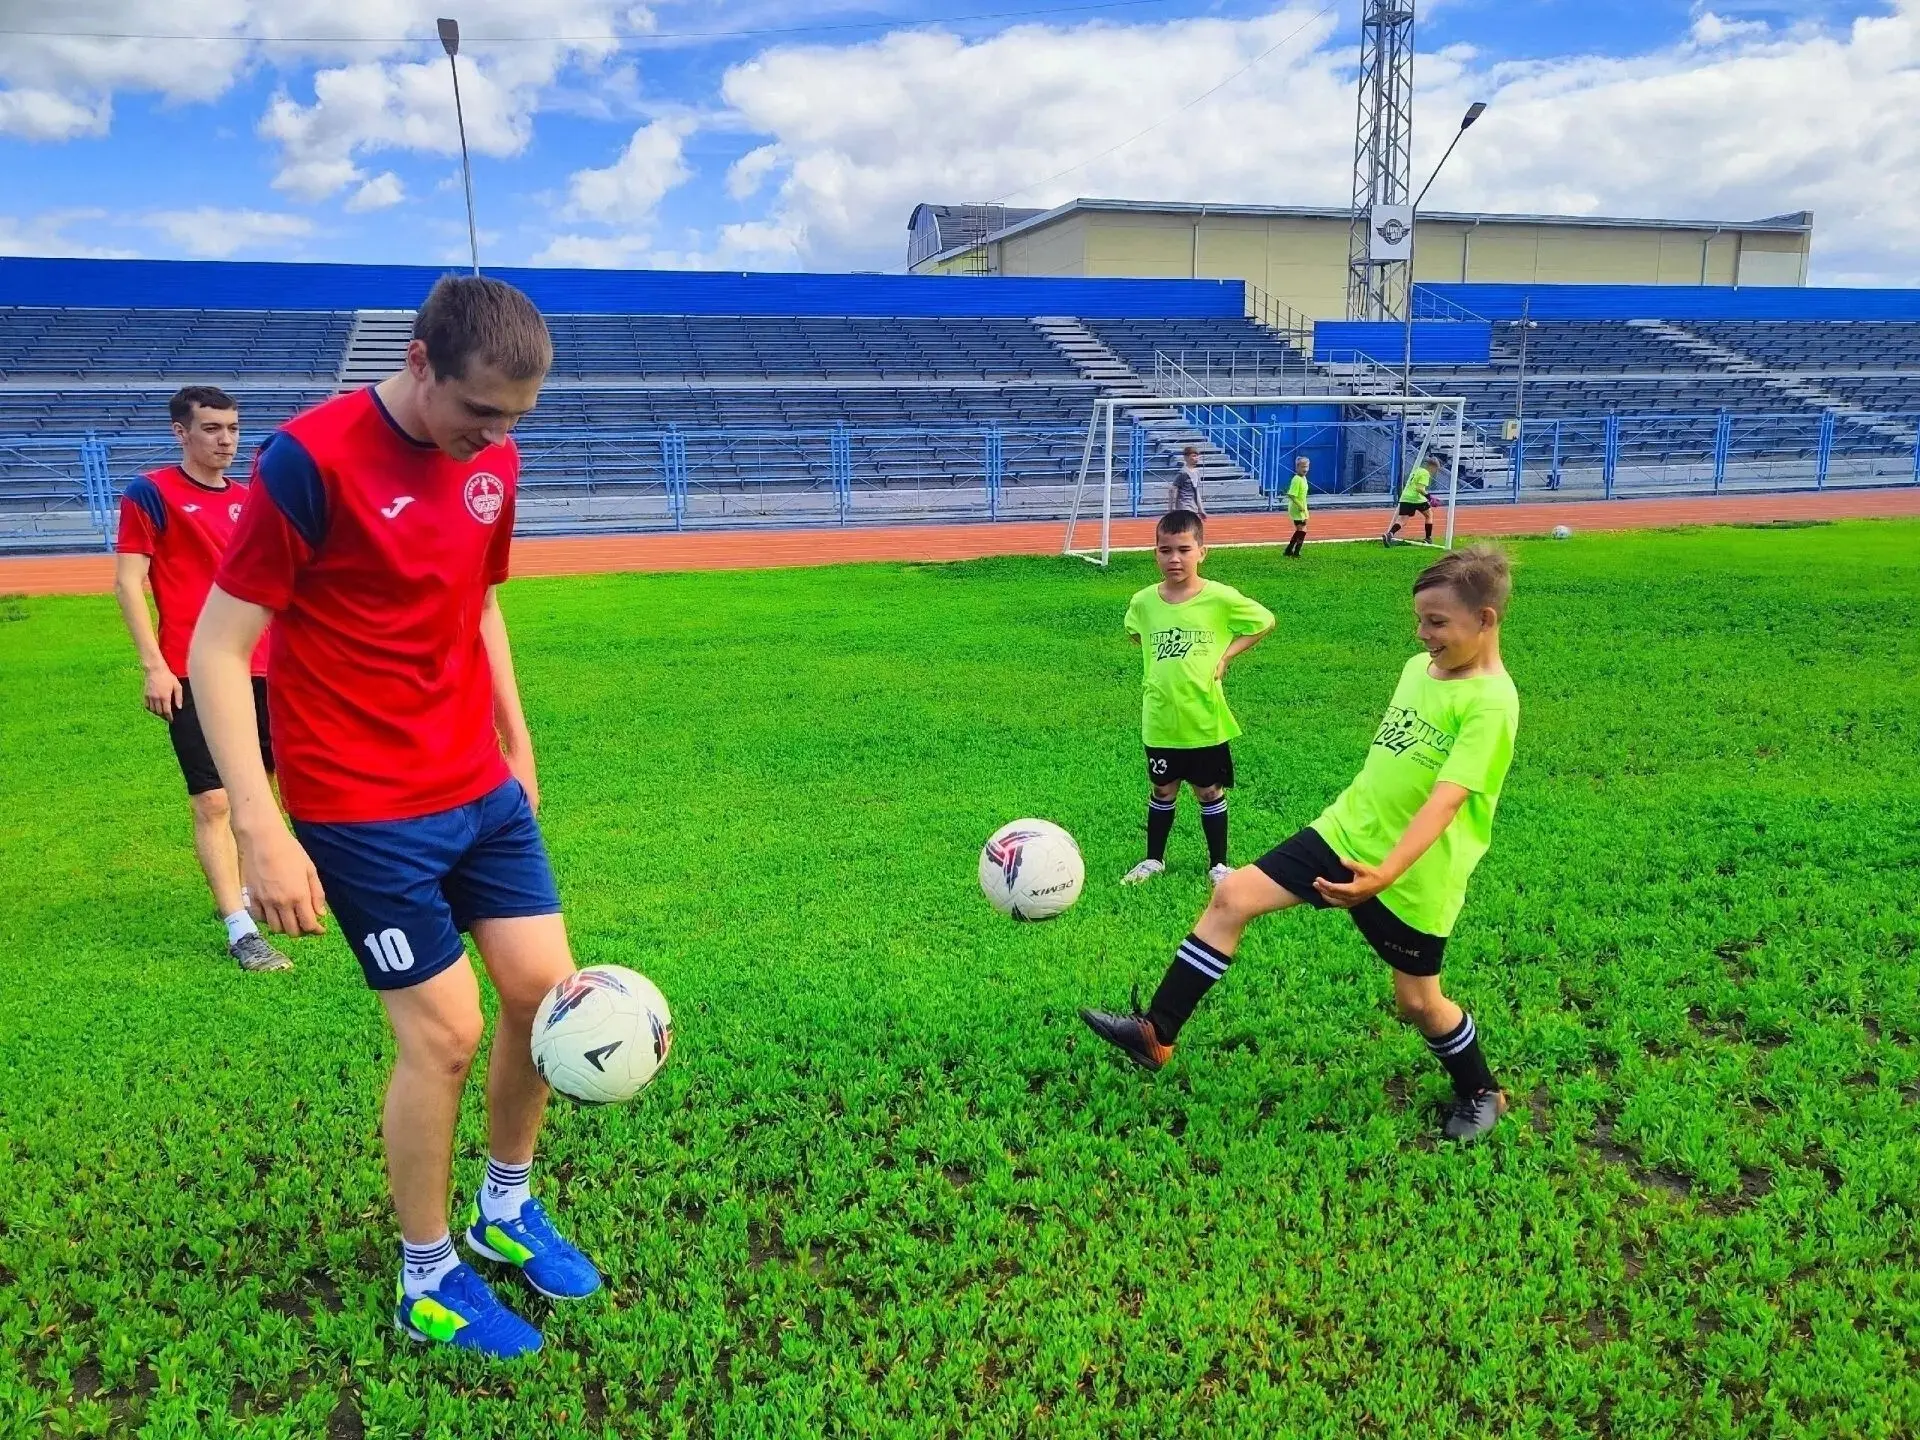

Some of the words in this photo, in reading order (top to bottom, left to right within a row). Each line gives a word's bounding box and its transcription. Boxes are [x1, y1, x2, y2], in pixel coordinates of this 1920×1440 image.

[1157, 642, 1193, 662] 2024
[1373, 722, 1418, 757] 2024
[1149, 757, 1168, 775] 23
[1029, 879, 1074, 898] DEMIX
[363, 928, 415, 972] 10
[1384, 940, 1421, 958] KELME
